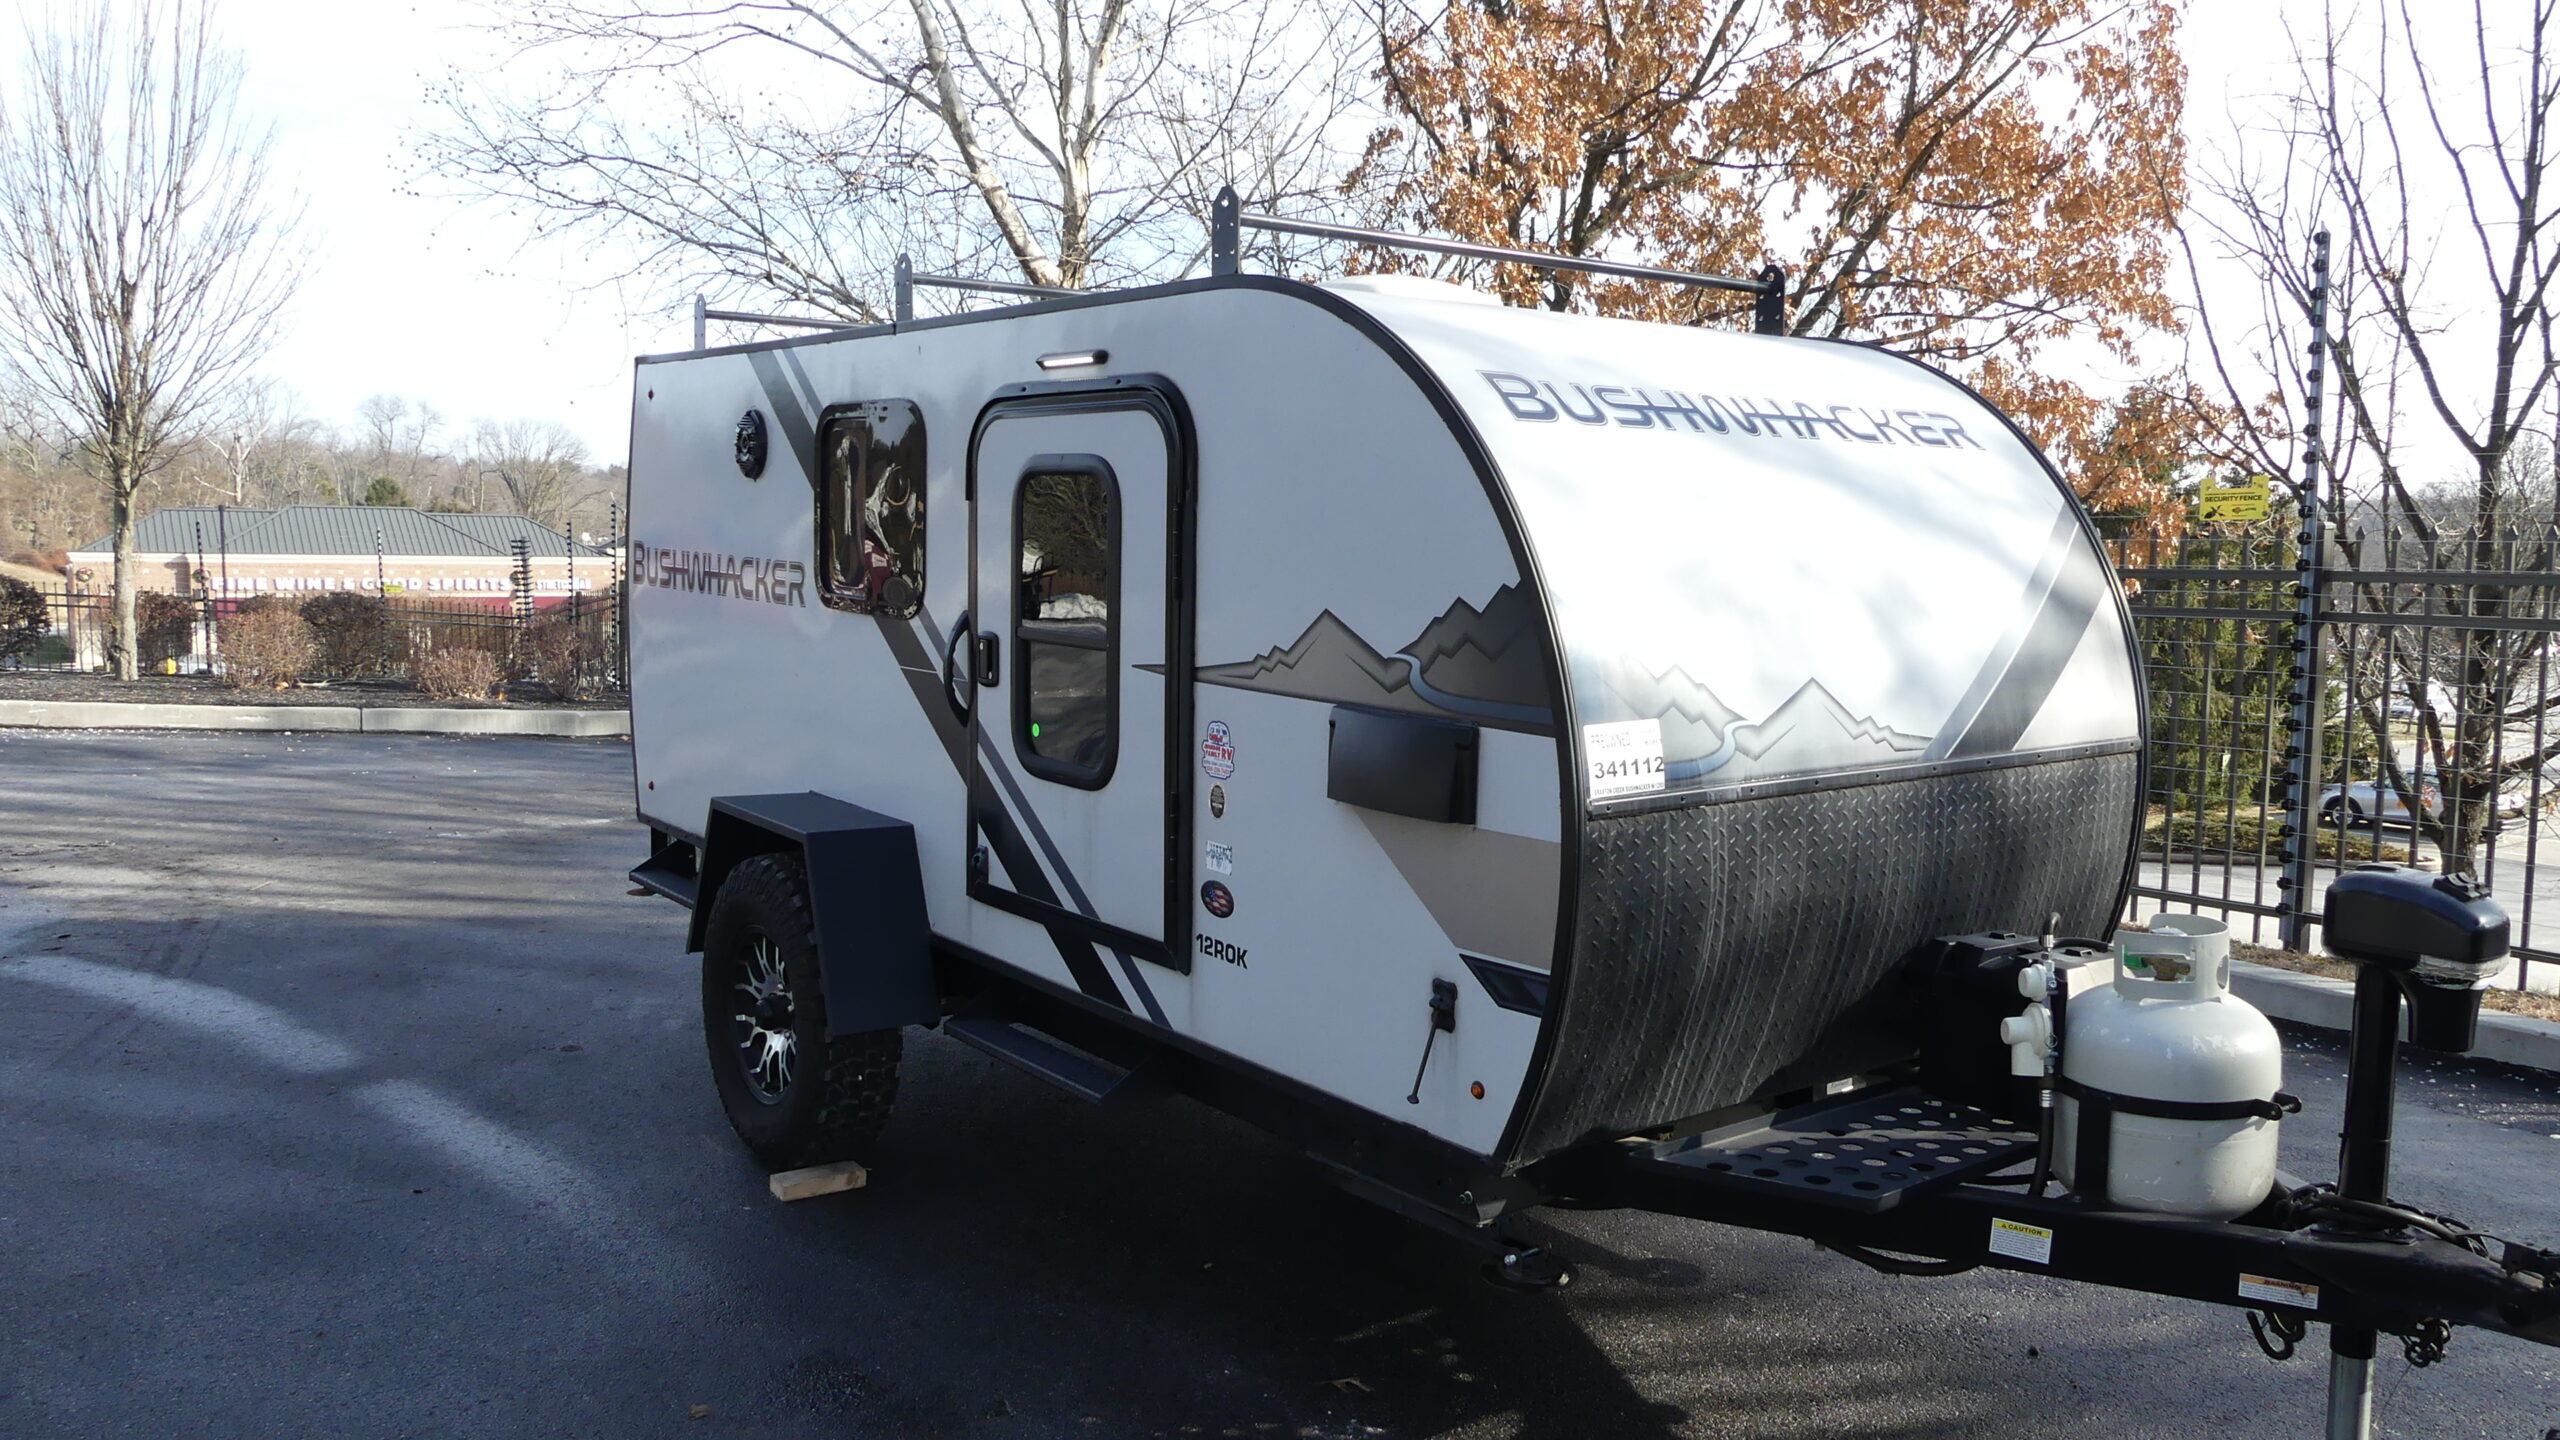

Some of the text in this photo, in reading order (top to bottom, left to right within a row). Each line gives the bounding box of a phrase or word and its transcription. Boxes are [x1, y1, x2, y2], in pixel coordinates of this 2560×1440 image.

[1475, 368, 1987, 451] BUSHWHACKER
[2204, 494, 2263, 503] SECURITY FENCE
[632, 540, 807, 608] BUSHWHACKER
[211, 577, 269, 591] FINE
[273, 577, 336, 591] WINE
[360, 577, 423, 591] GOOD
[427, 577, 513, 591] SPIRITS
[1221, 747, 1233, 761] RV
[1594, 756, 1665, 779] 341112
[2008, 1224, 2043, 1236] CAUTION
